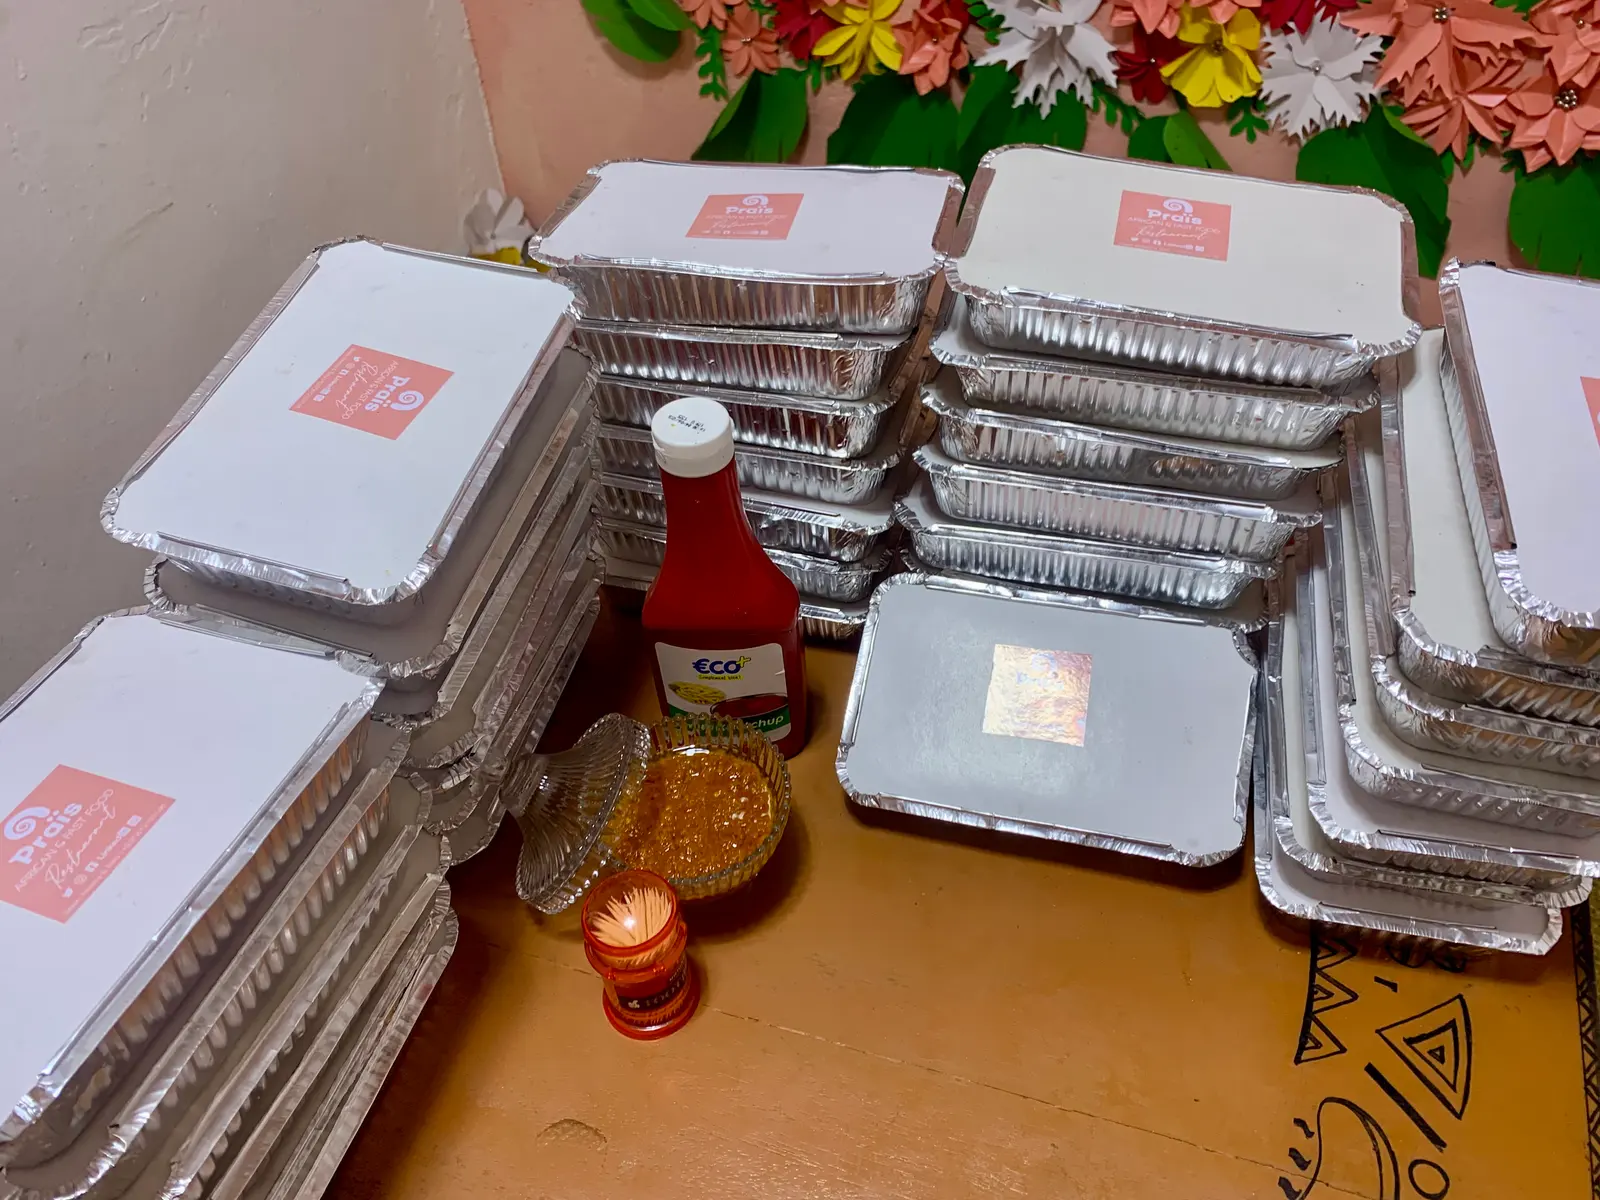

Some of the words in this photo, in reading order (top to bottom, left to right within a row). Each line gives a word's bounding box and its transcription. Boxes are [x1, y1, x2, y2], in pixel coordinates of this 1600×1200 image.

[15, 847, 58, 892] AFRICAN
[62, 816, 87, 839] FAST
[84, 788, 114, 816] FOOD
